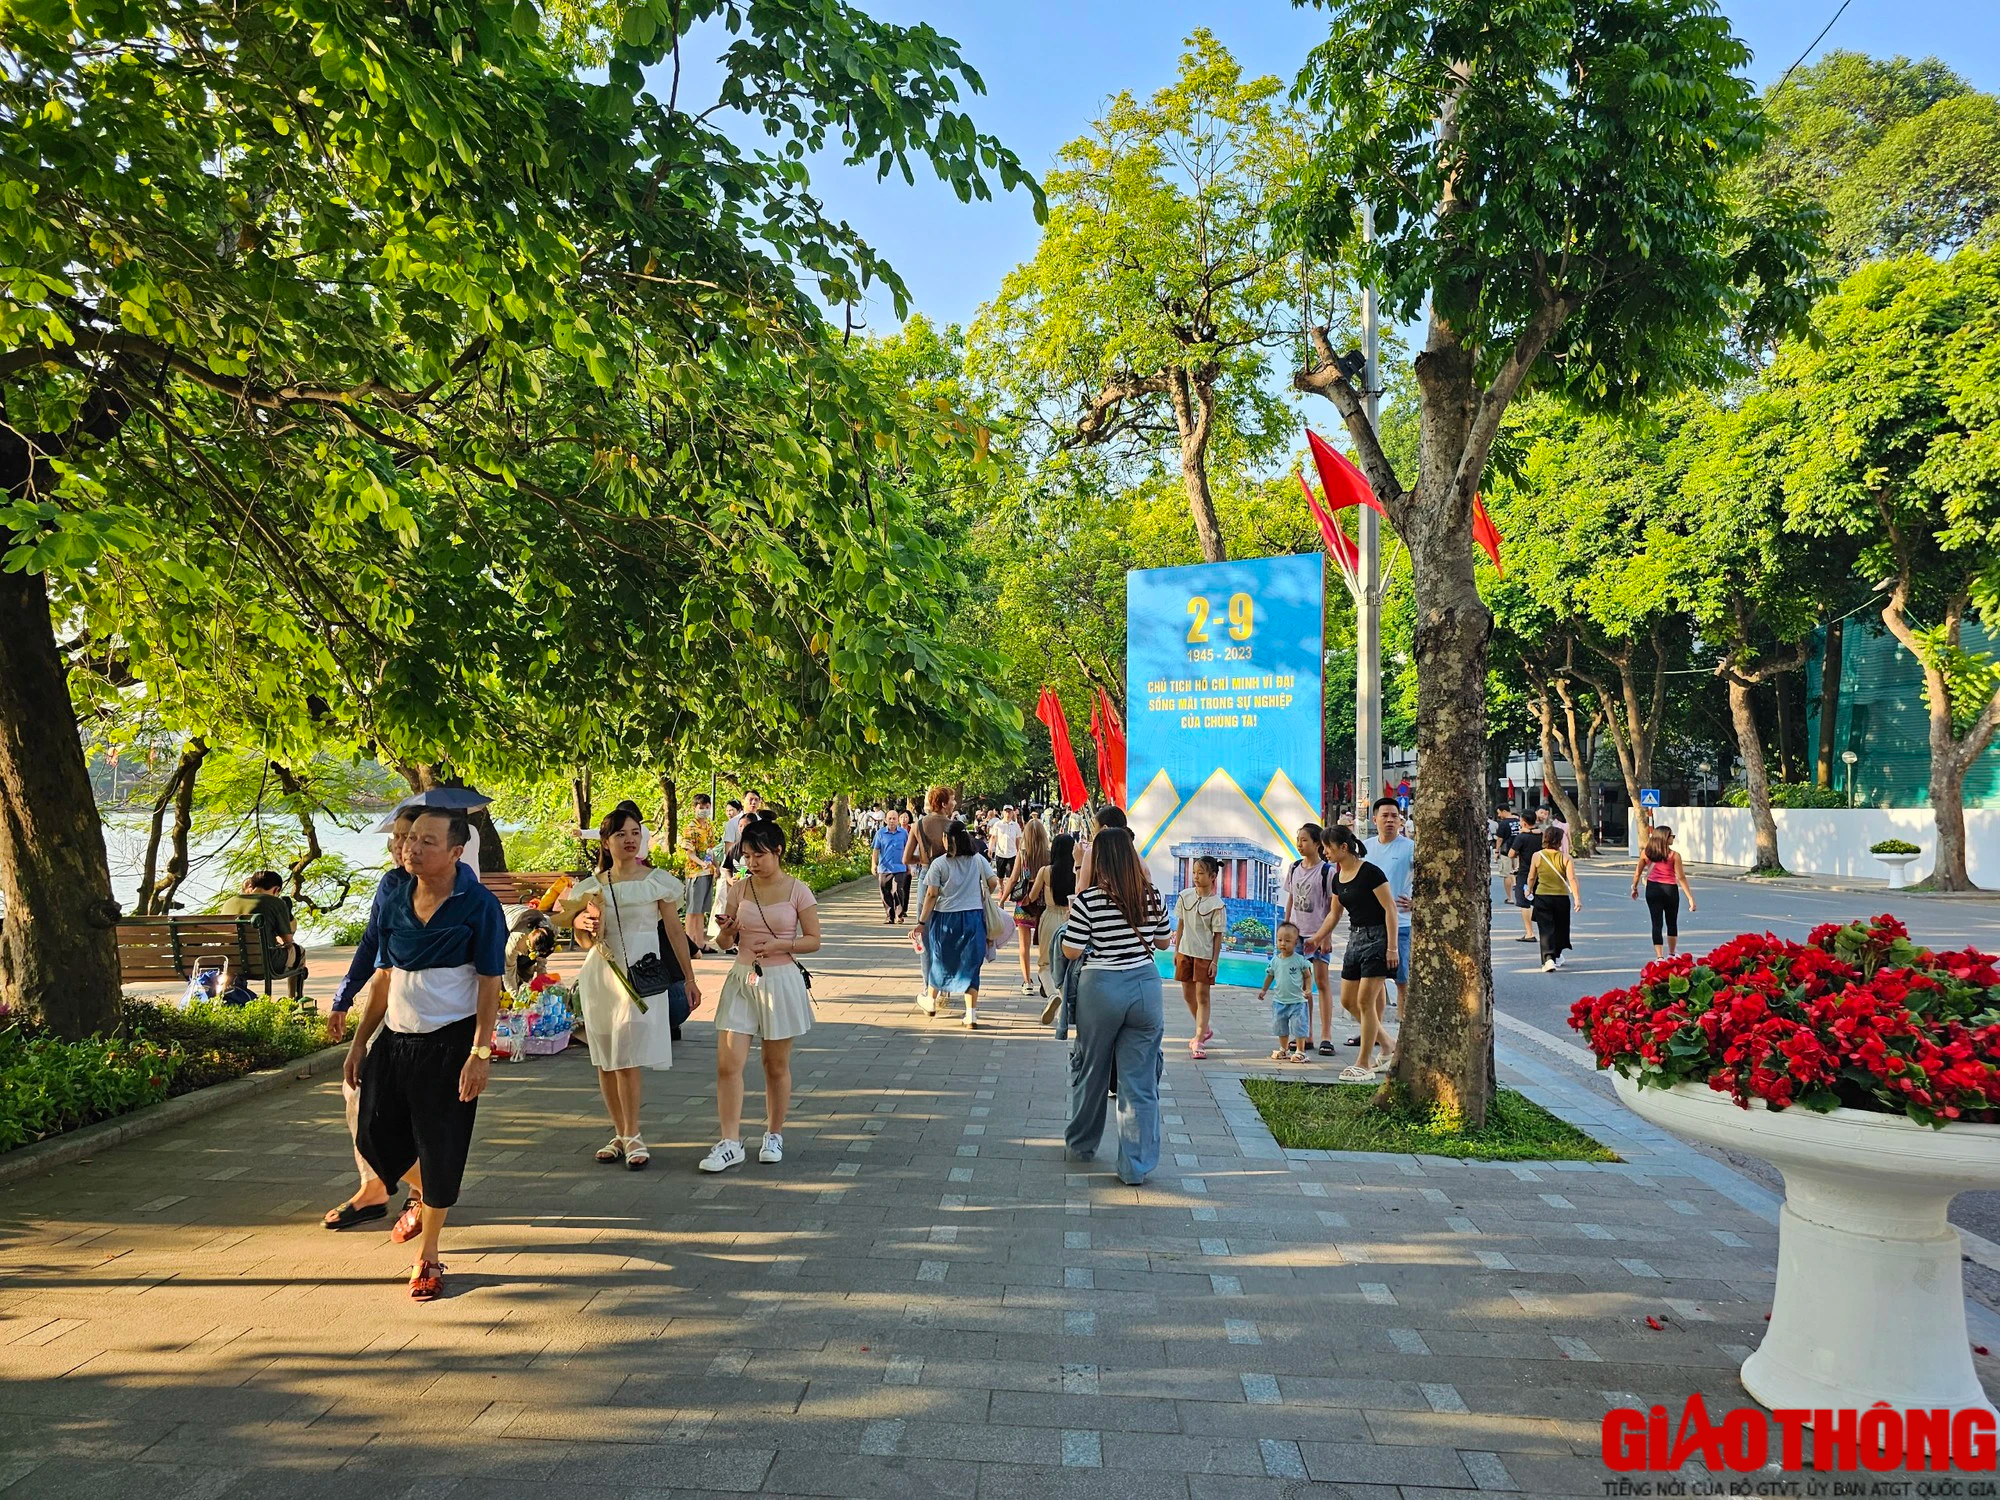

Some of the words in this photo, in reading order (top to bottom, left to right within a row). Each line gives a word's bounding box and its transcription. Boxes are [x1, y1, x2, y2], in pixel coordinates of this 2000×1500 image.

[1186, 592, 1254, 643] 2-9
[1187, 649, 1214, 662] 1945
[1224, 646, 1253, 661] 2023
[1147, 678, 1167, 693] CHỦ
[1170, 680, 1192, 694] TỊCH
[1211, 676, 1229, 691] CHÍ
[1231, 676, 1259, 690] MINH
[1275, 675, 1295, 691] ĐẠI
[1148, 695, 1175, 711] SỐNG
[1200, 697, 1234, 710] TRONG
[1236, 695, 1251, 711] SỰ
[1254, 692, 1293, 710] NGHIỆP
[1180, 712, 1201, 728] CỦA
[1203, 714, 1239, 728] CHÚNG
[1241, 715, 1257, 727] TA!
